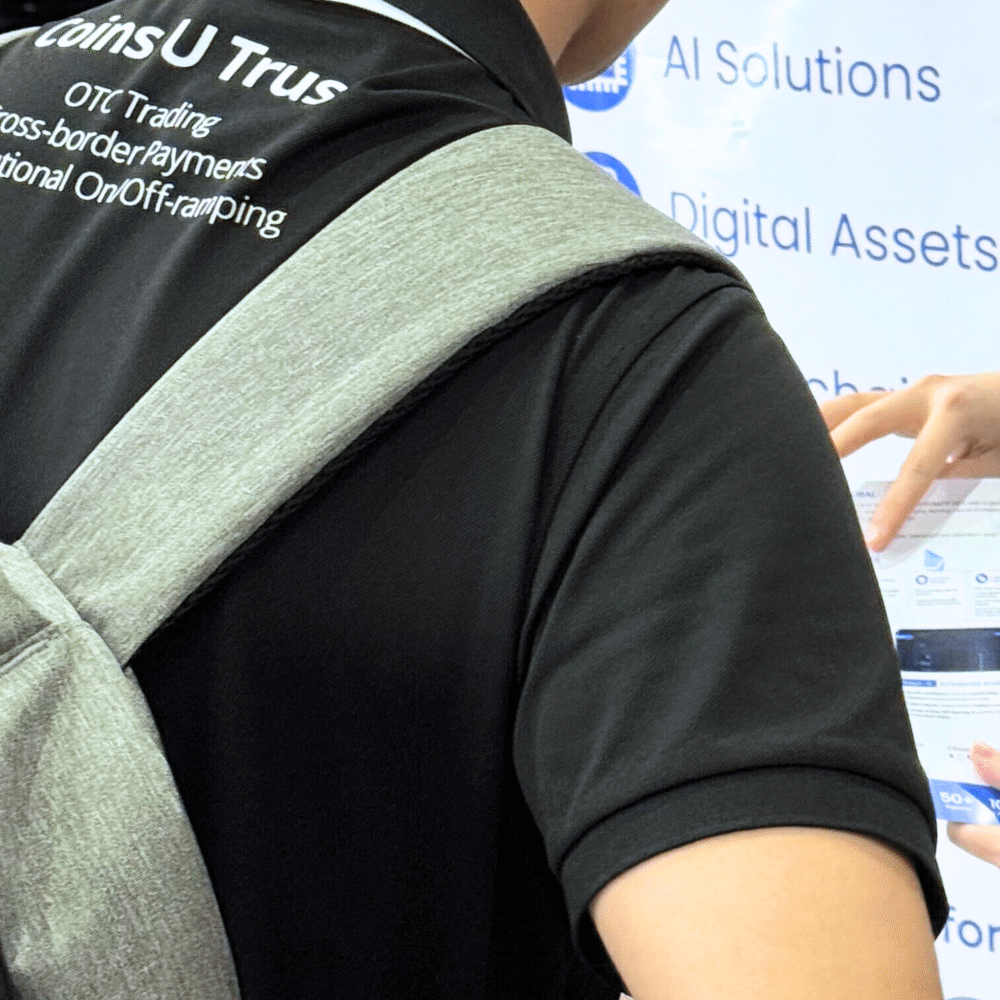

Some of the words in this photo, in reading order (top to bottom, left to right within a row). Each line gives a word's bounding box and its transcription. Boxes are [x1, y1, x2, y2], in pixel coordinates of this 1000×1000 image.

[664, 35, 699, 81] AI
[716, 40, 941, 103] Solutions
[64, 82, 123, 114] OTC
[124, 90, 222, 138] Trading
[75, 171, 288, 239] On/Off-ramping
[671, 191, 812, 258] Digital
[831, 213, 998, 272] Assets
